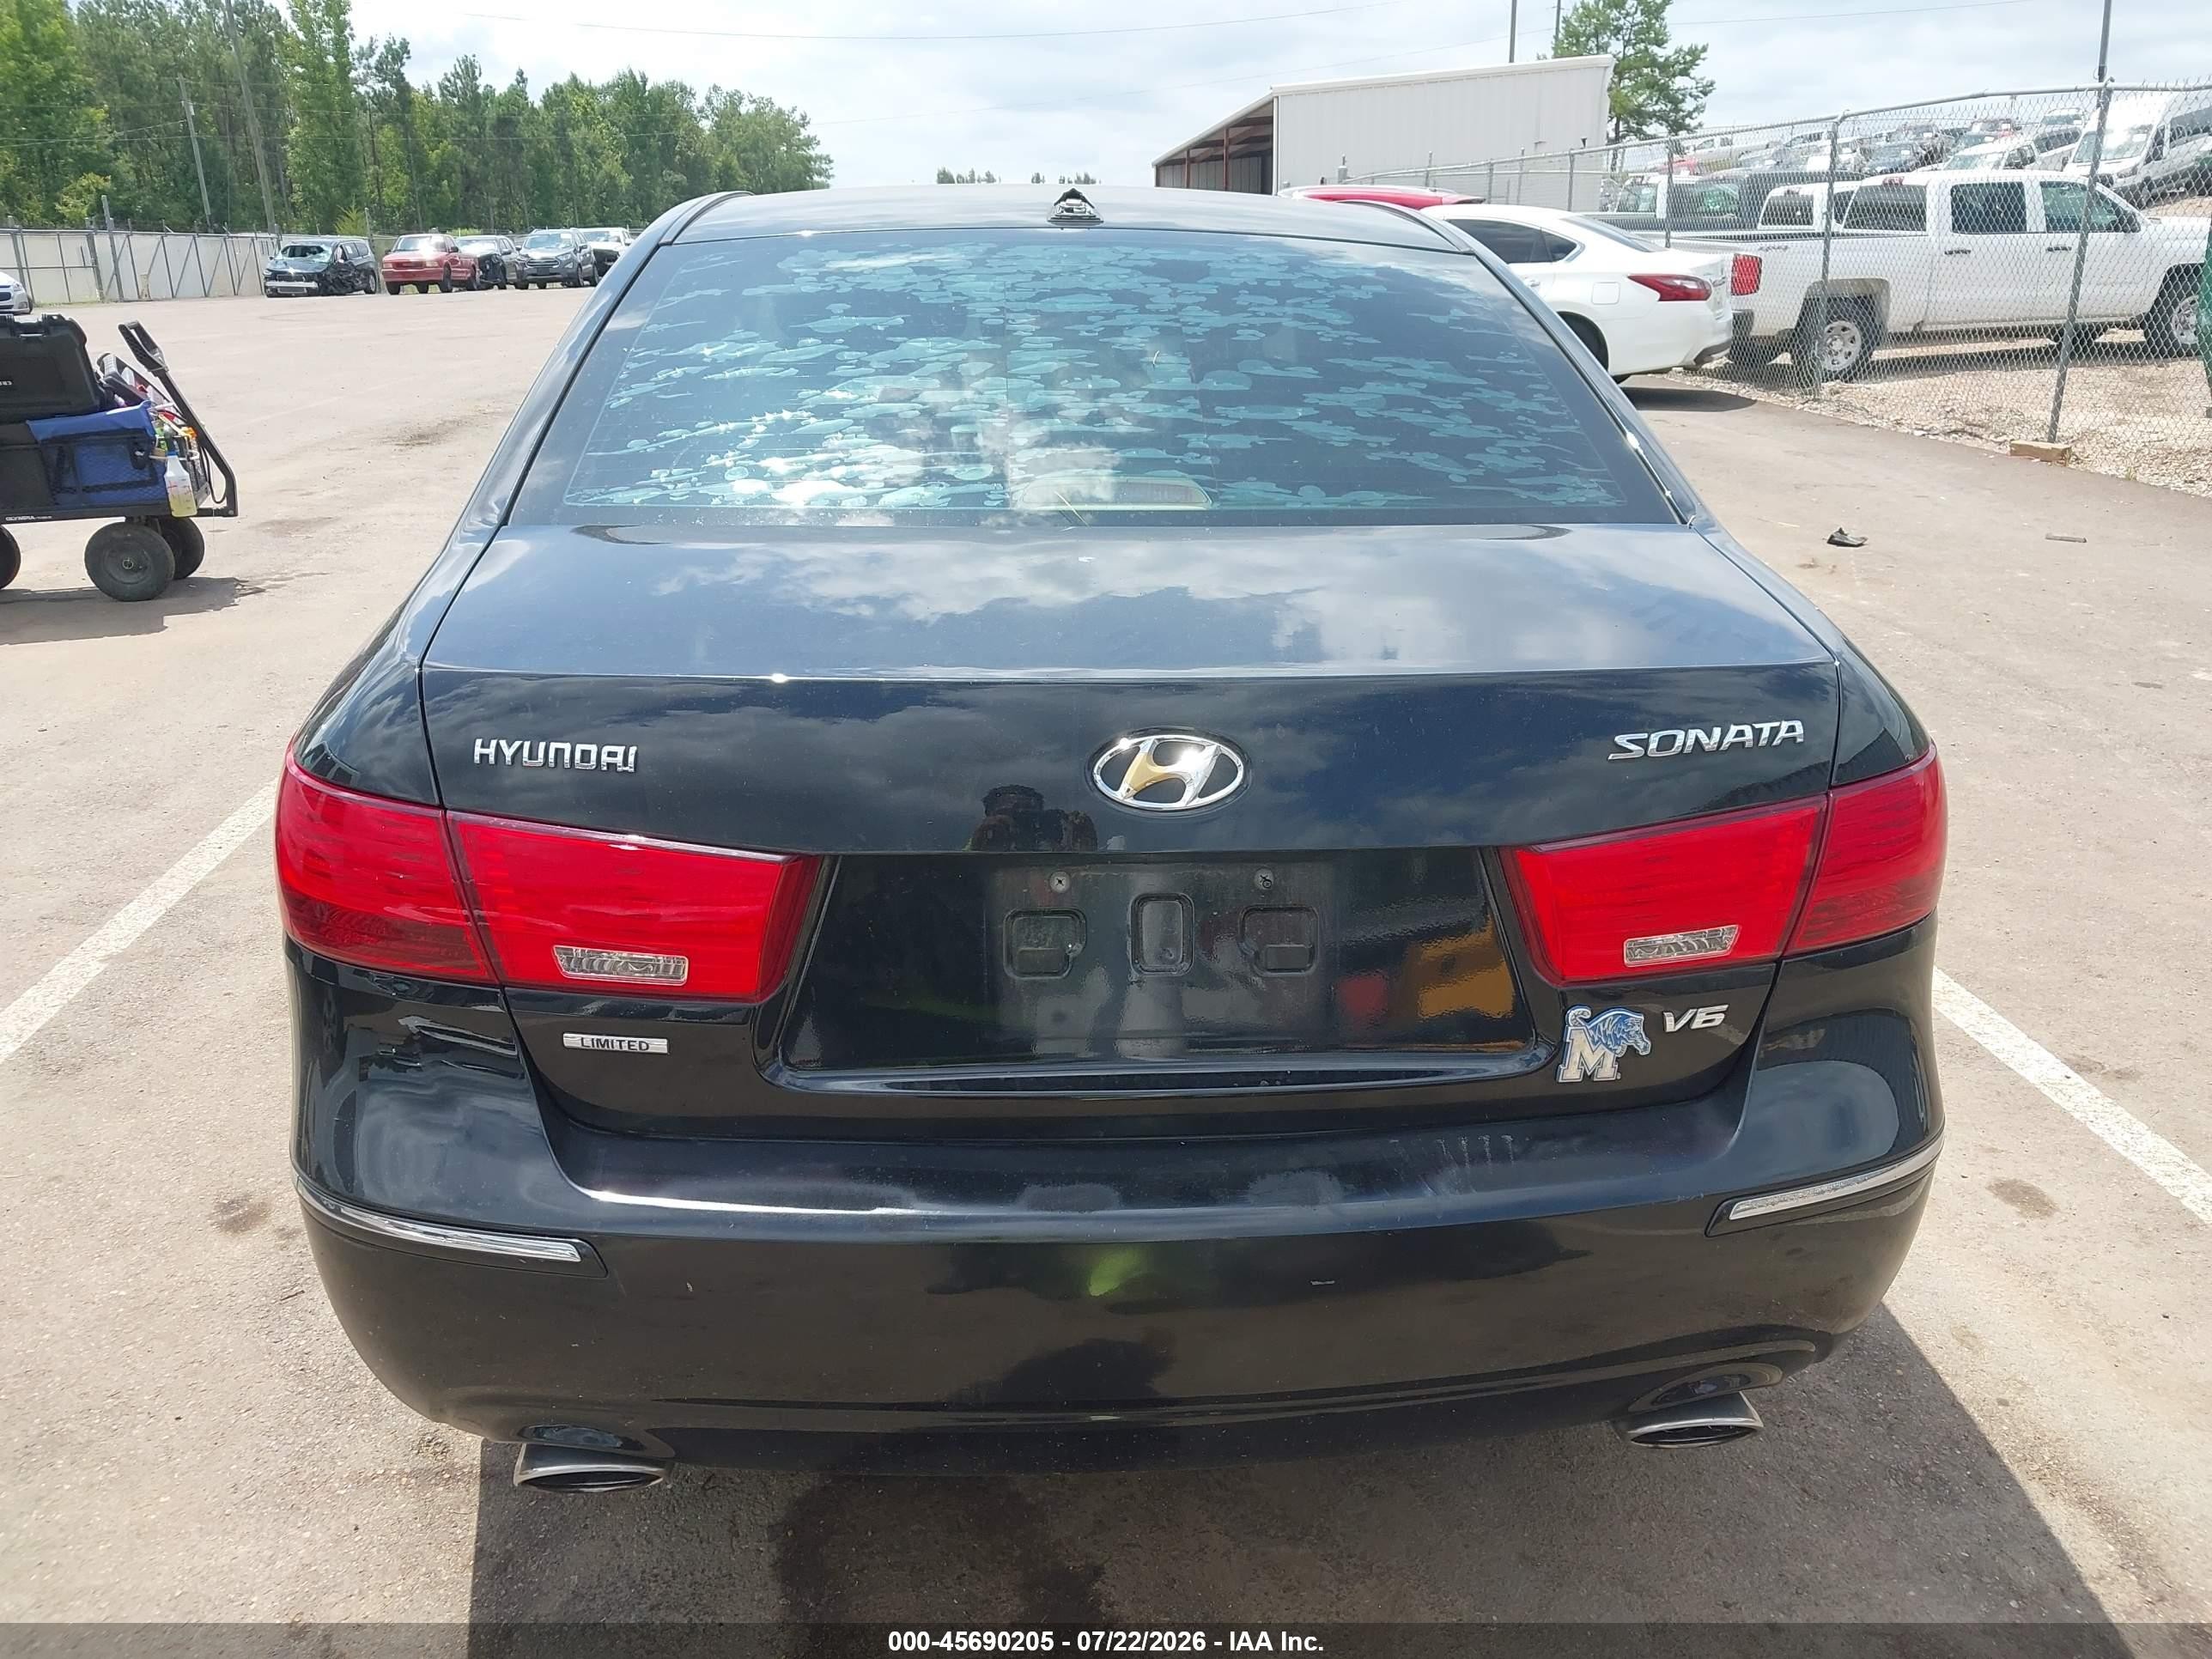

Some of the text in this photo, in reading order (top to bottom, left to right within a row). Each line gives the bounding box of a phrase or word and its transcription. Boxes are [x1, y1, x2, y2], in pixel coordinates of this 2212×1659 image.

[473, 738, 637, 773] HYUNDAI
[1607, 720, 1804, 761] SONATA
[1663, 1004, 1729, 1033] V6
[580, 1036, 650, 1052] LIMITED
